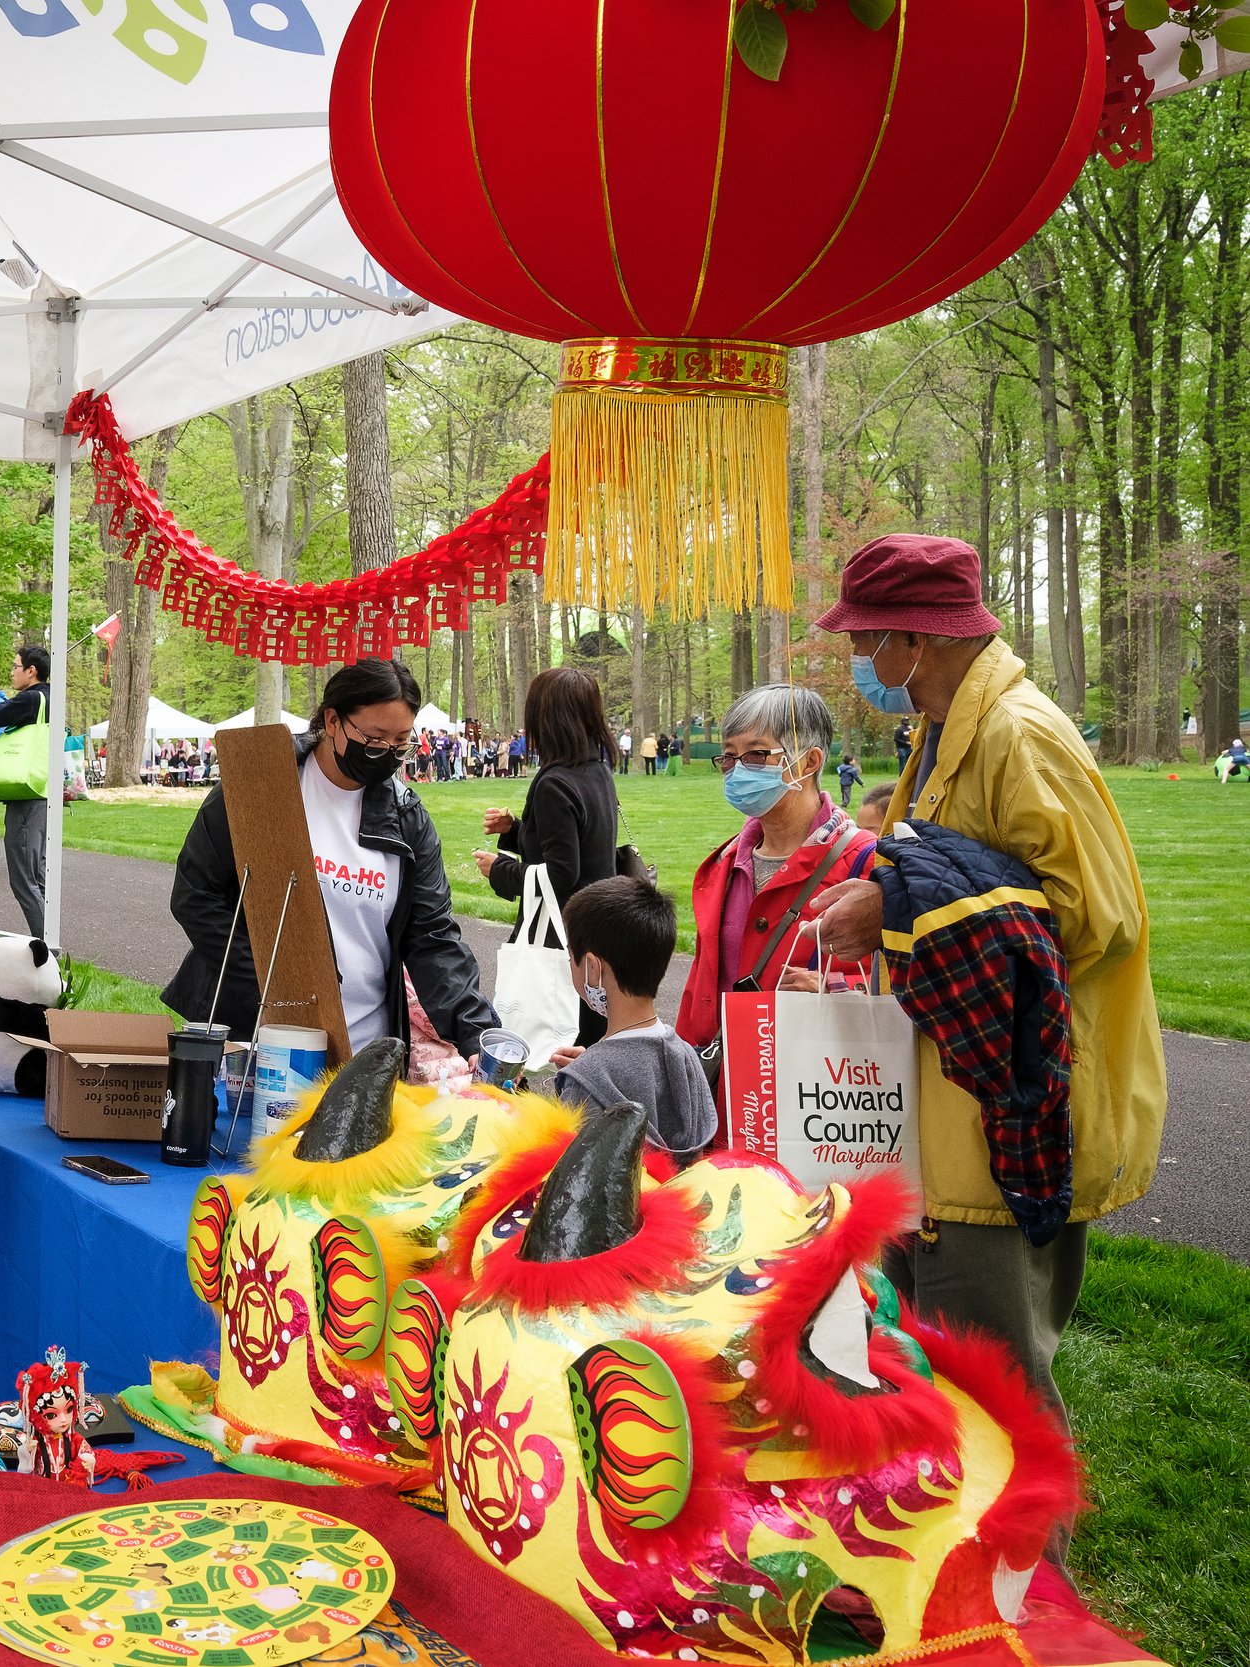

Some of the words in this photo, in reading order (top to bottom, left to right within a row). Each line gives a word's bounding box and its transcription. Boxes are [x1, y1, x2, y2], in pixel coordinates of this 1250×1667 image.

[333, 880, 385, 901] YOUTH
[825, 1057, 881, 1086] Visit
[77, 1078, 129, 1090] business.
[132, 1079, 163, 1090] small
[85, 1092, 102, 1103] for
[105, 1092, 140, 1104] goods
[143, 1093, 162, 1104] the
[798, 1082, 904, 1111] Howard
[103, 1106, 161, 1119] Delivering
[803, 1114, 902, 1152] County
[166, 1145, 188, 1154] contigo
[813, 1144, 902, 1170] Maryland
[121, 1538, 141, 1547] Dog
[154, 1533, 178, 1547] Horse
[241, 1631, 273, 1645] Snake
[154, 1639, 195, 1655] Rooster
